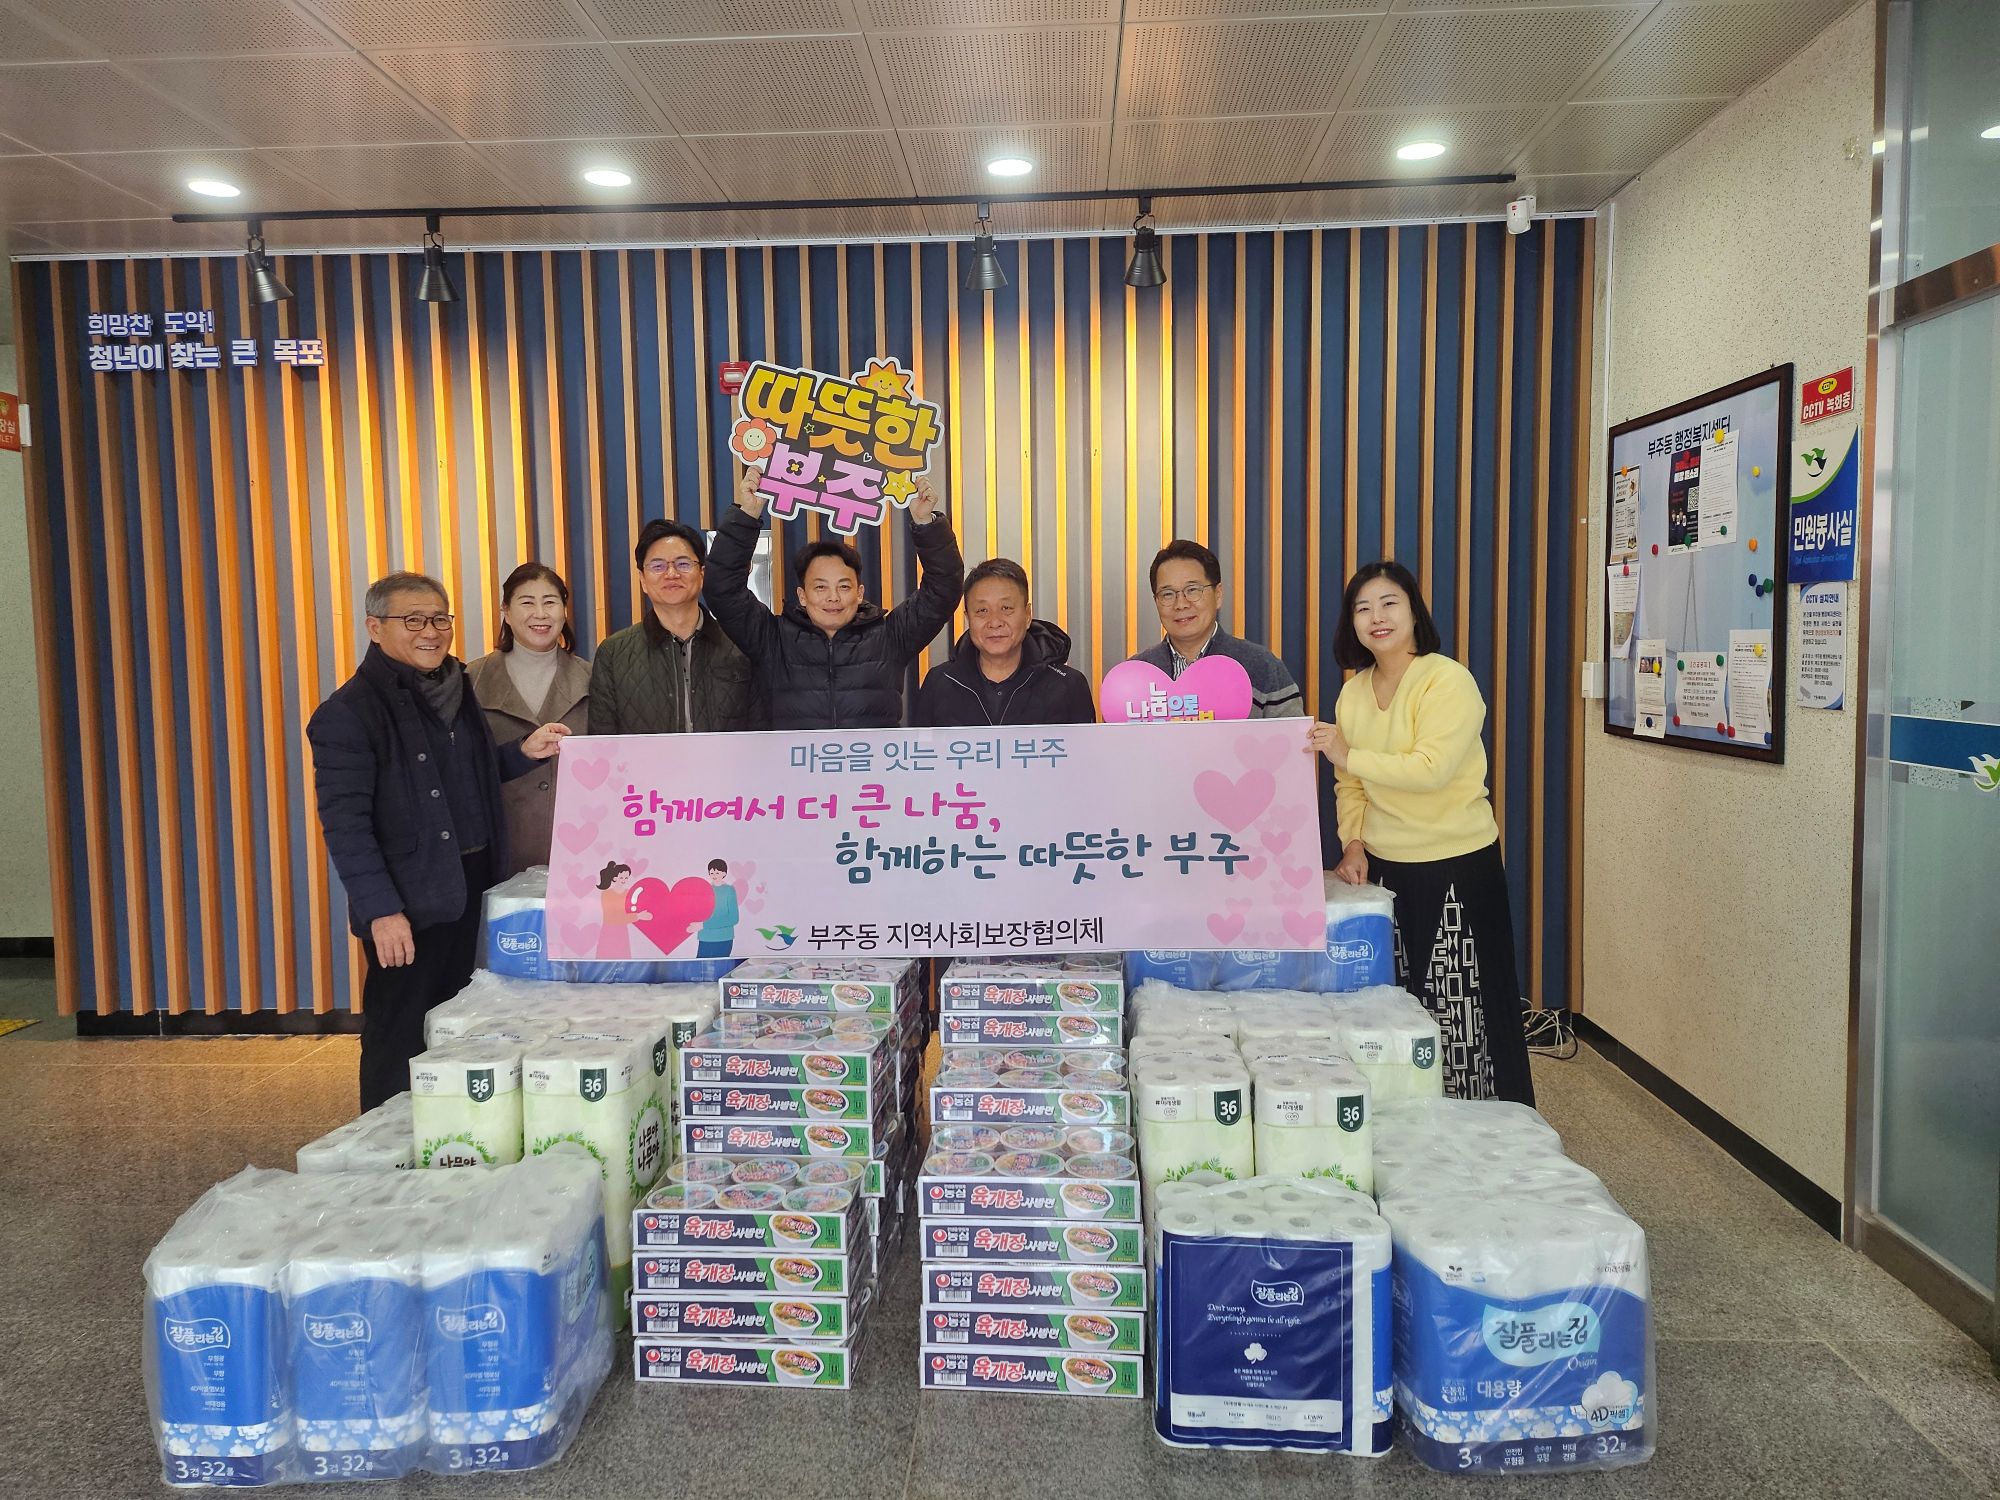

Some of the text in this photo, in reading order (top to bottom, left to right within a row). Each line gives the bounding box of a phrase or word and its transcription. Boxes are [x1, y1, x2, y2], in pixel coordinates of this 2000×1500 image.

[88, 310, 214, 336] 희망찬 도약!
[89, 338, 325, 372] 청년이 찾는 큰 목포
[1802, 391, 1851, 420] CCTV 녹화중
[745, 368, 938, 470] 따뜻한
[1647, 414, 1731, 459] 부주동 행정복지센터
[759, 442, 883, 530] 부주
[1794, 510, 1853, 552] 민원봉사실
[1805, 594, 1818, 604] CCTV
[1126, 682, 1199, 718] 나눔으로
[790, 738, 1068, 774] 마음을 잇는 우리 부주
[622, 784, 1001, 836] 함께여서 더 큰 나눔,
[835, 830, 1250, 885] 함께하는 따뜻한 부주
[807, 917, 1104, 950] 부주동 지역사회보장협의체
[501, 936, 538, 950] 잘풀리는집
[1330, 945, 1369, 959] 잘풀리는집
[740, 986, 757, 996] 농심
[961, 988, 980, 996] 농심
[961, 1020, 980, 1030] 농심
[677, 1030, 692, 1043] 36
[654, 1048, 665, 1068] 36
[1417, 1046, 1432, 1060] 36
[702, 1058, 721, 1067] 농심
[472, 1079, 490, 1093] 36
[584, 1078, 602, 1093] 36
[702, 1092, 721, 1102] 농심
[953, 1096, 973, 1106] 농심
[1220, 1100, 1238, 1116] 36
[1343, 1105, 1360, 1122] 36
[639, 1120, 659, 1149] 나무야
[704, 1130, 723, 1139] 농심
[637, 1139, 660, 1171] 나무야
[944, 1188, 966, 1198] 농심
[658, 1217, 679, 1229] 농심
[947, 1231, 969, 1242] 농심
[658, 1261, 680, 1273] 농심
[951, 1275, 972, 1287] 농심
[1256, 1286, 1299, 1302] 잘풀리는집
[658, 1305, 679, 1317] 농심
[1207, 1303, 1225, 1311] Don't
[948, 1317, 970, 1328] 농심
[1245, 1317, 1266, 1325] gonna
[1268, 1315, 1275, 1324] be
[1275, 1316, 1284, 1324] all
[170, 1325, 224, 1346] 잘풀리는집
[309, 1320, 364, 1341] 잘풀리는집
[1492, 1315, 1588, 1354] 잘풀리는집
[660, 1350, 681, 1361] 농심
[946, 1358, 968, 1369] 농심
[1568, 1355, 1598, 1371] Origin
[1477, 1379, 1522, 1399] 대용량
